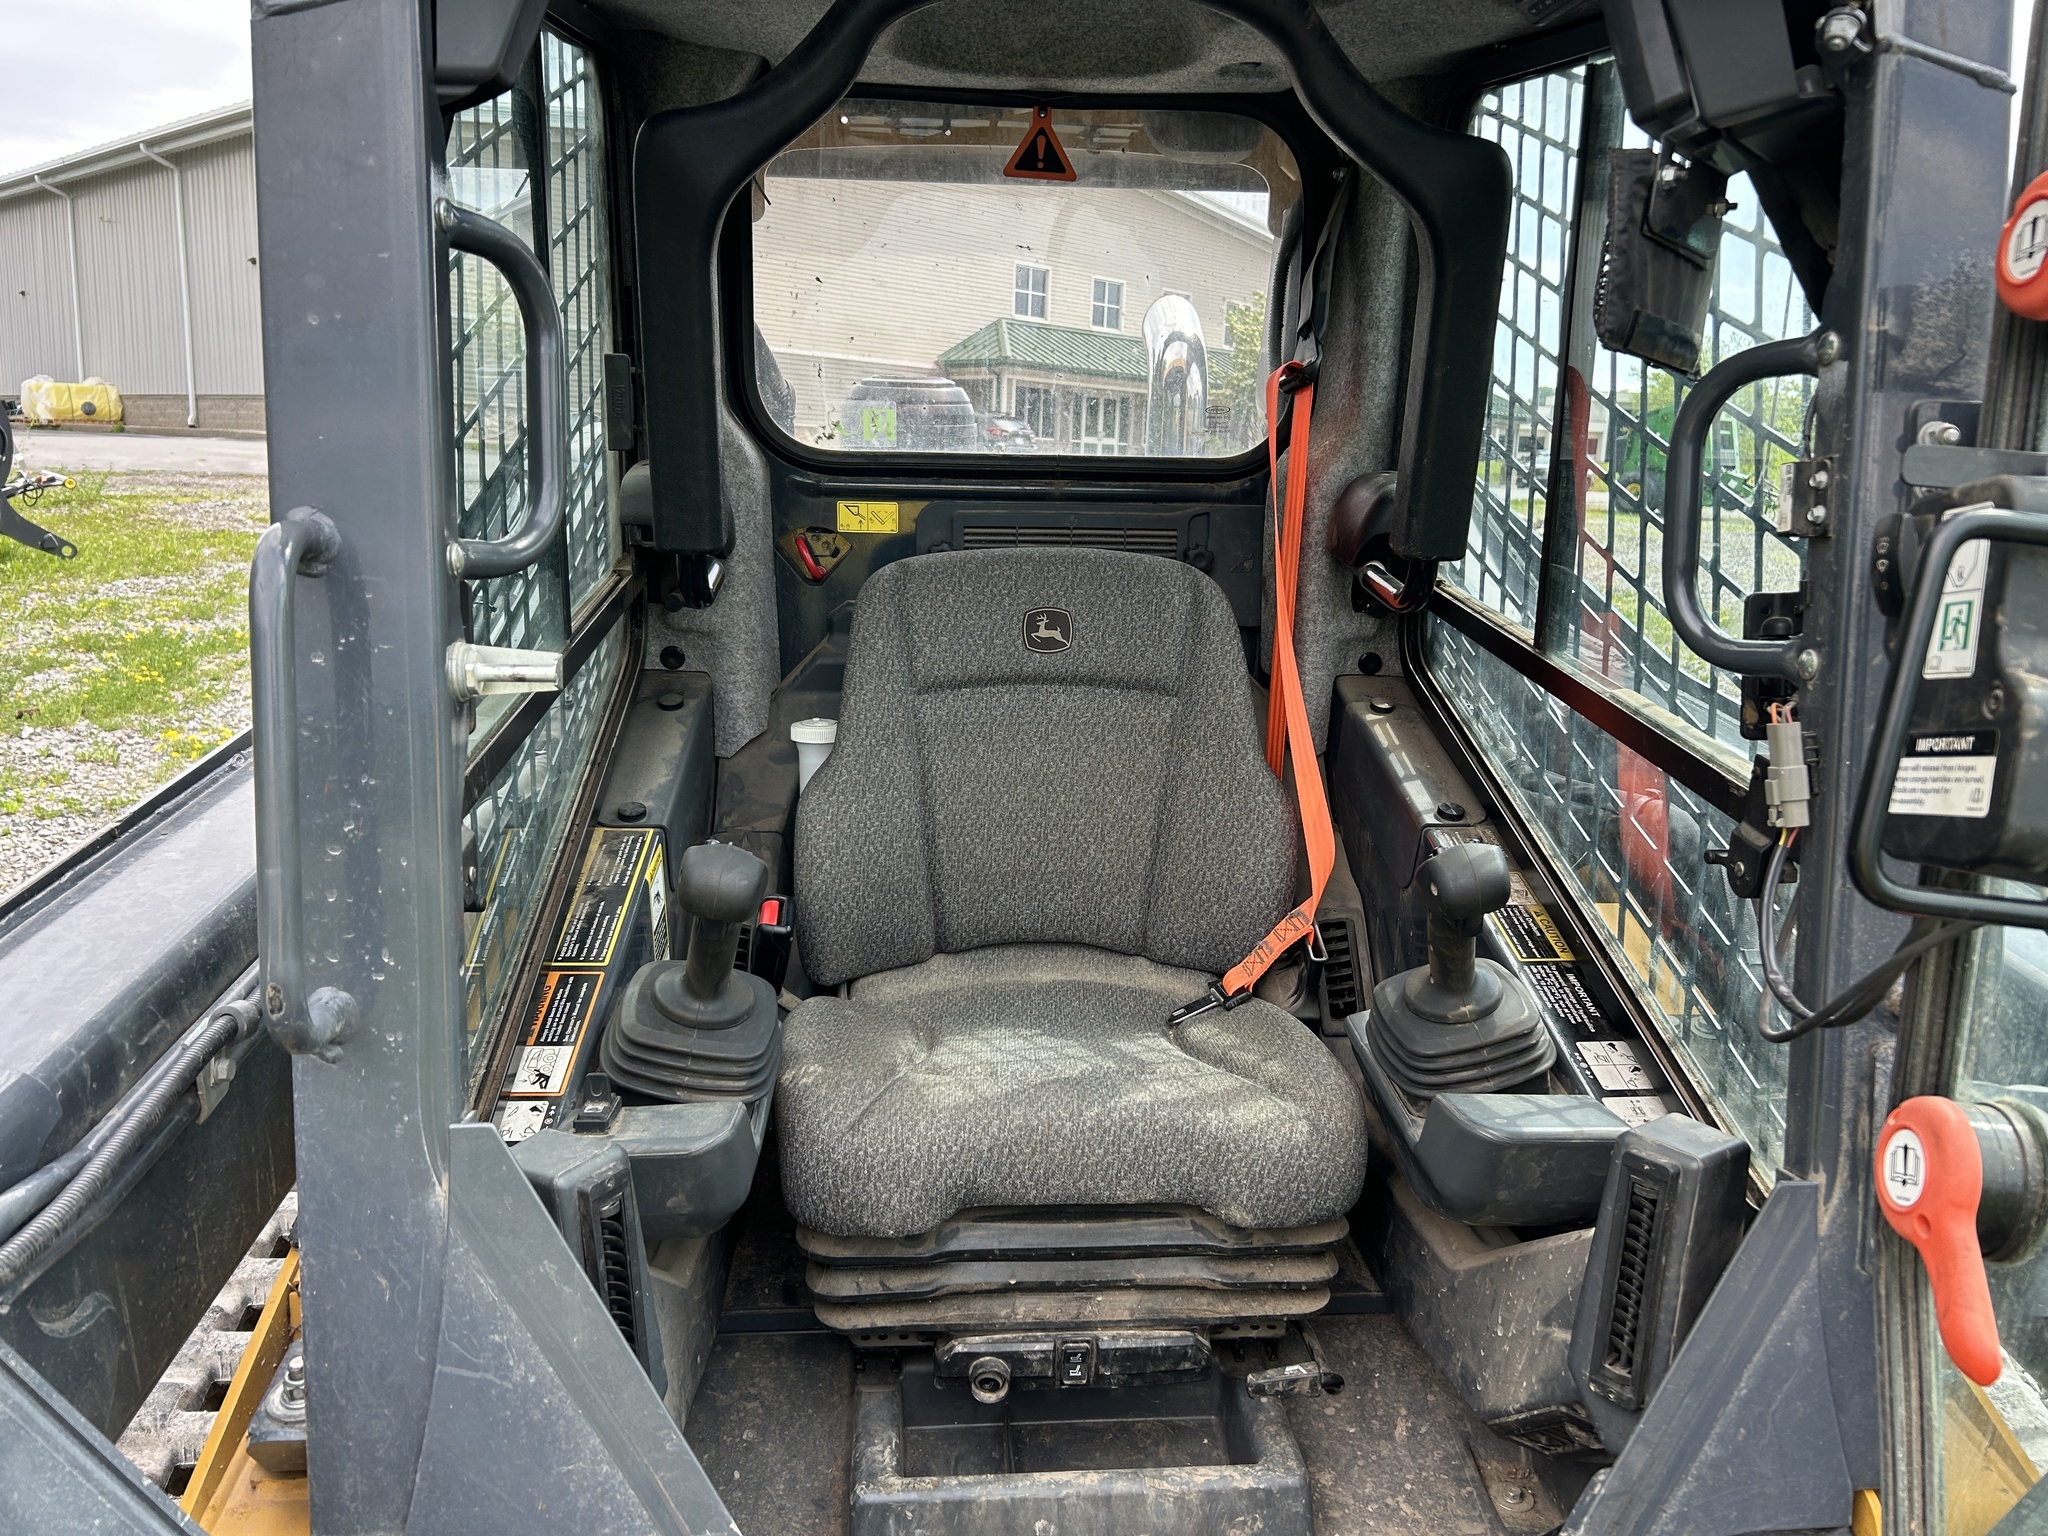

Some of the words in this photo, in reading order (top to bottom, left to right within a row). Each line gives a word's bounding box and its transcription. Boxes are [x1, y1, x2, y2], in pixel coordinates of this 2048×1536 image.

[1915, 736, 1975, 752] IMPORTANT
[1540, 918, 1570, 954] CAUTION
[533, 986, 551, 1026] WARNING
[1566, 973, 1601, 1018] IMPORTANT
